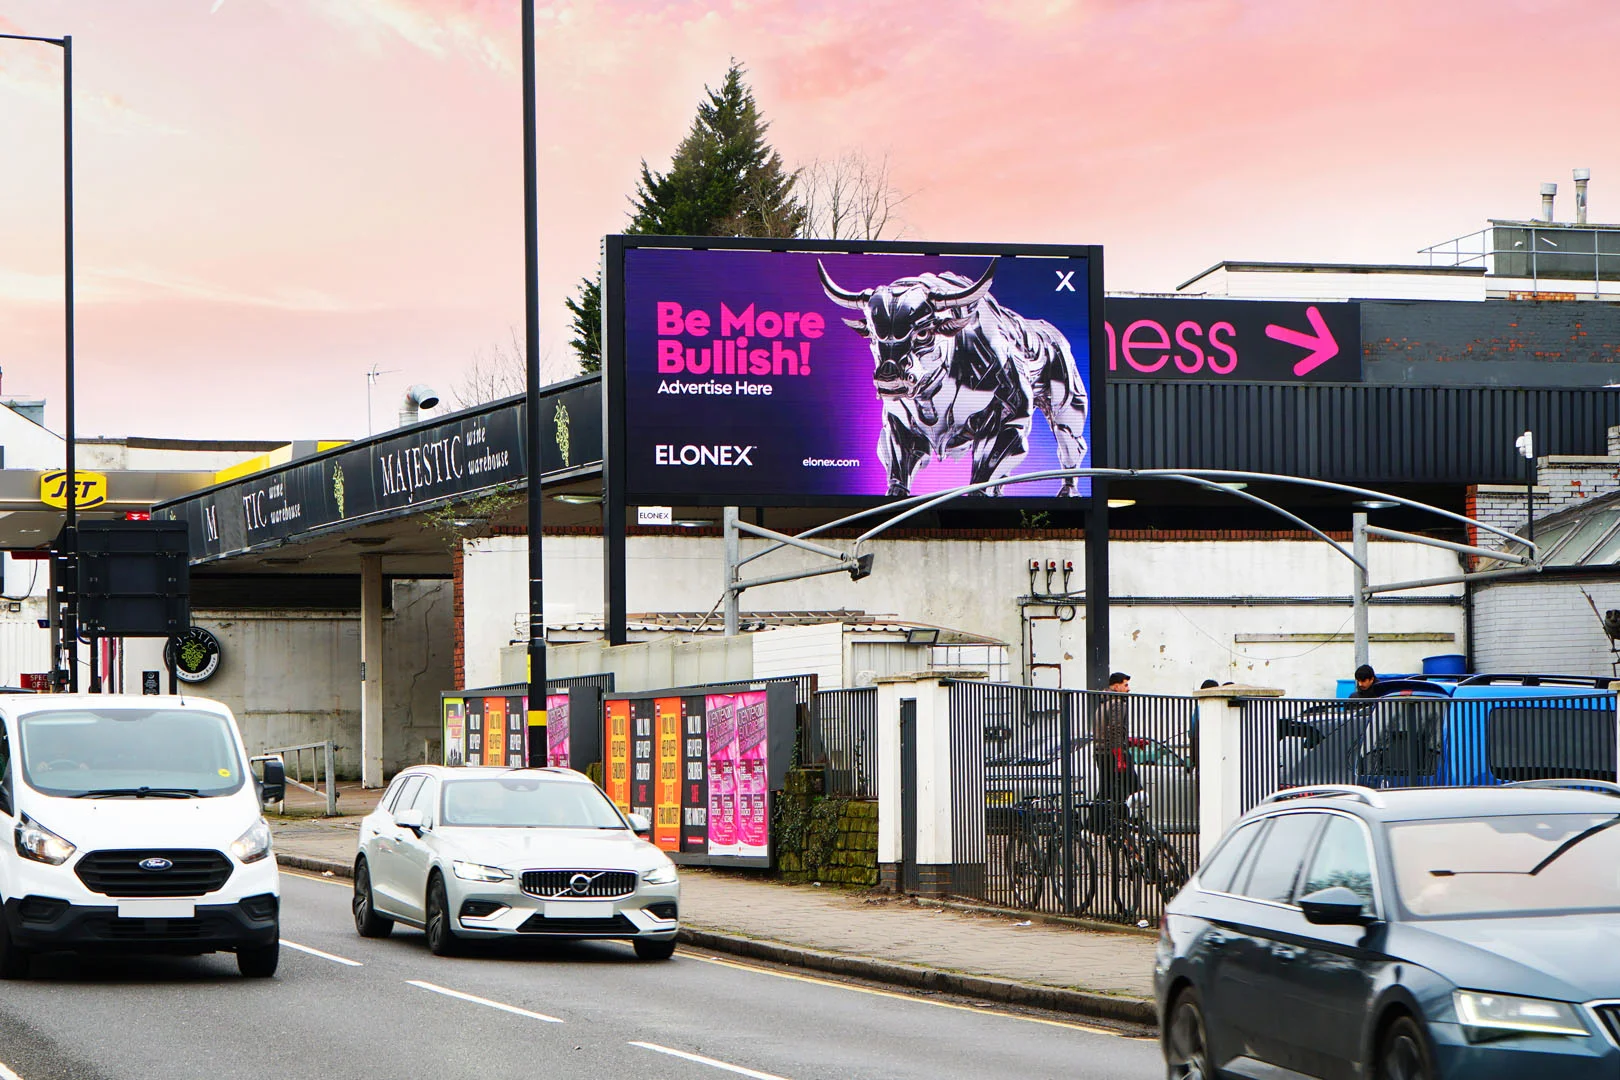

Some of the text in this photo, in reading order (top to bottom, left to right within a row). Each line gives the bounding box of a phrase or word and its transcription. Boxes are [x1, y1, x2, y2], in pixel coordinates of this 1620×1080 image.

[1055, 270, 1076, 292] X
[657, 302, 825, 339] Be More
[657, 336, 811, 376] Bullish!
[657, 380, 773, 396] Advertise Here
[466, 422, 486, 446] wine
[380, 435, 463, 503] MAJESTIC
[468, 446, 509, 475] warehouse
[802, 456, 860, 468] elonex.com
[269, 479, 284, 500] wine
[269, 502, 301, 525] warehouse
[639, 512, 669, 520] ELONEX
[32, 681, 49, 689] OFFE
